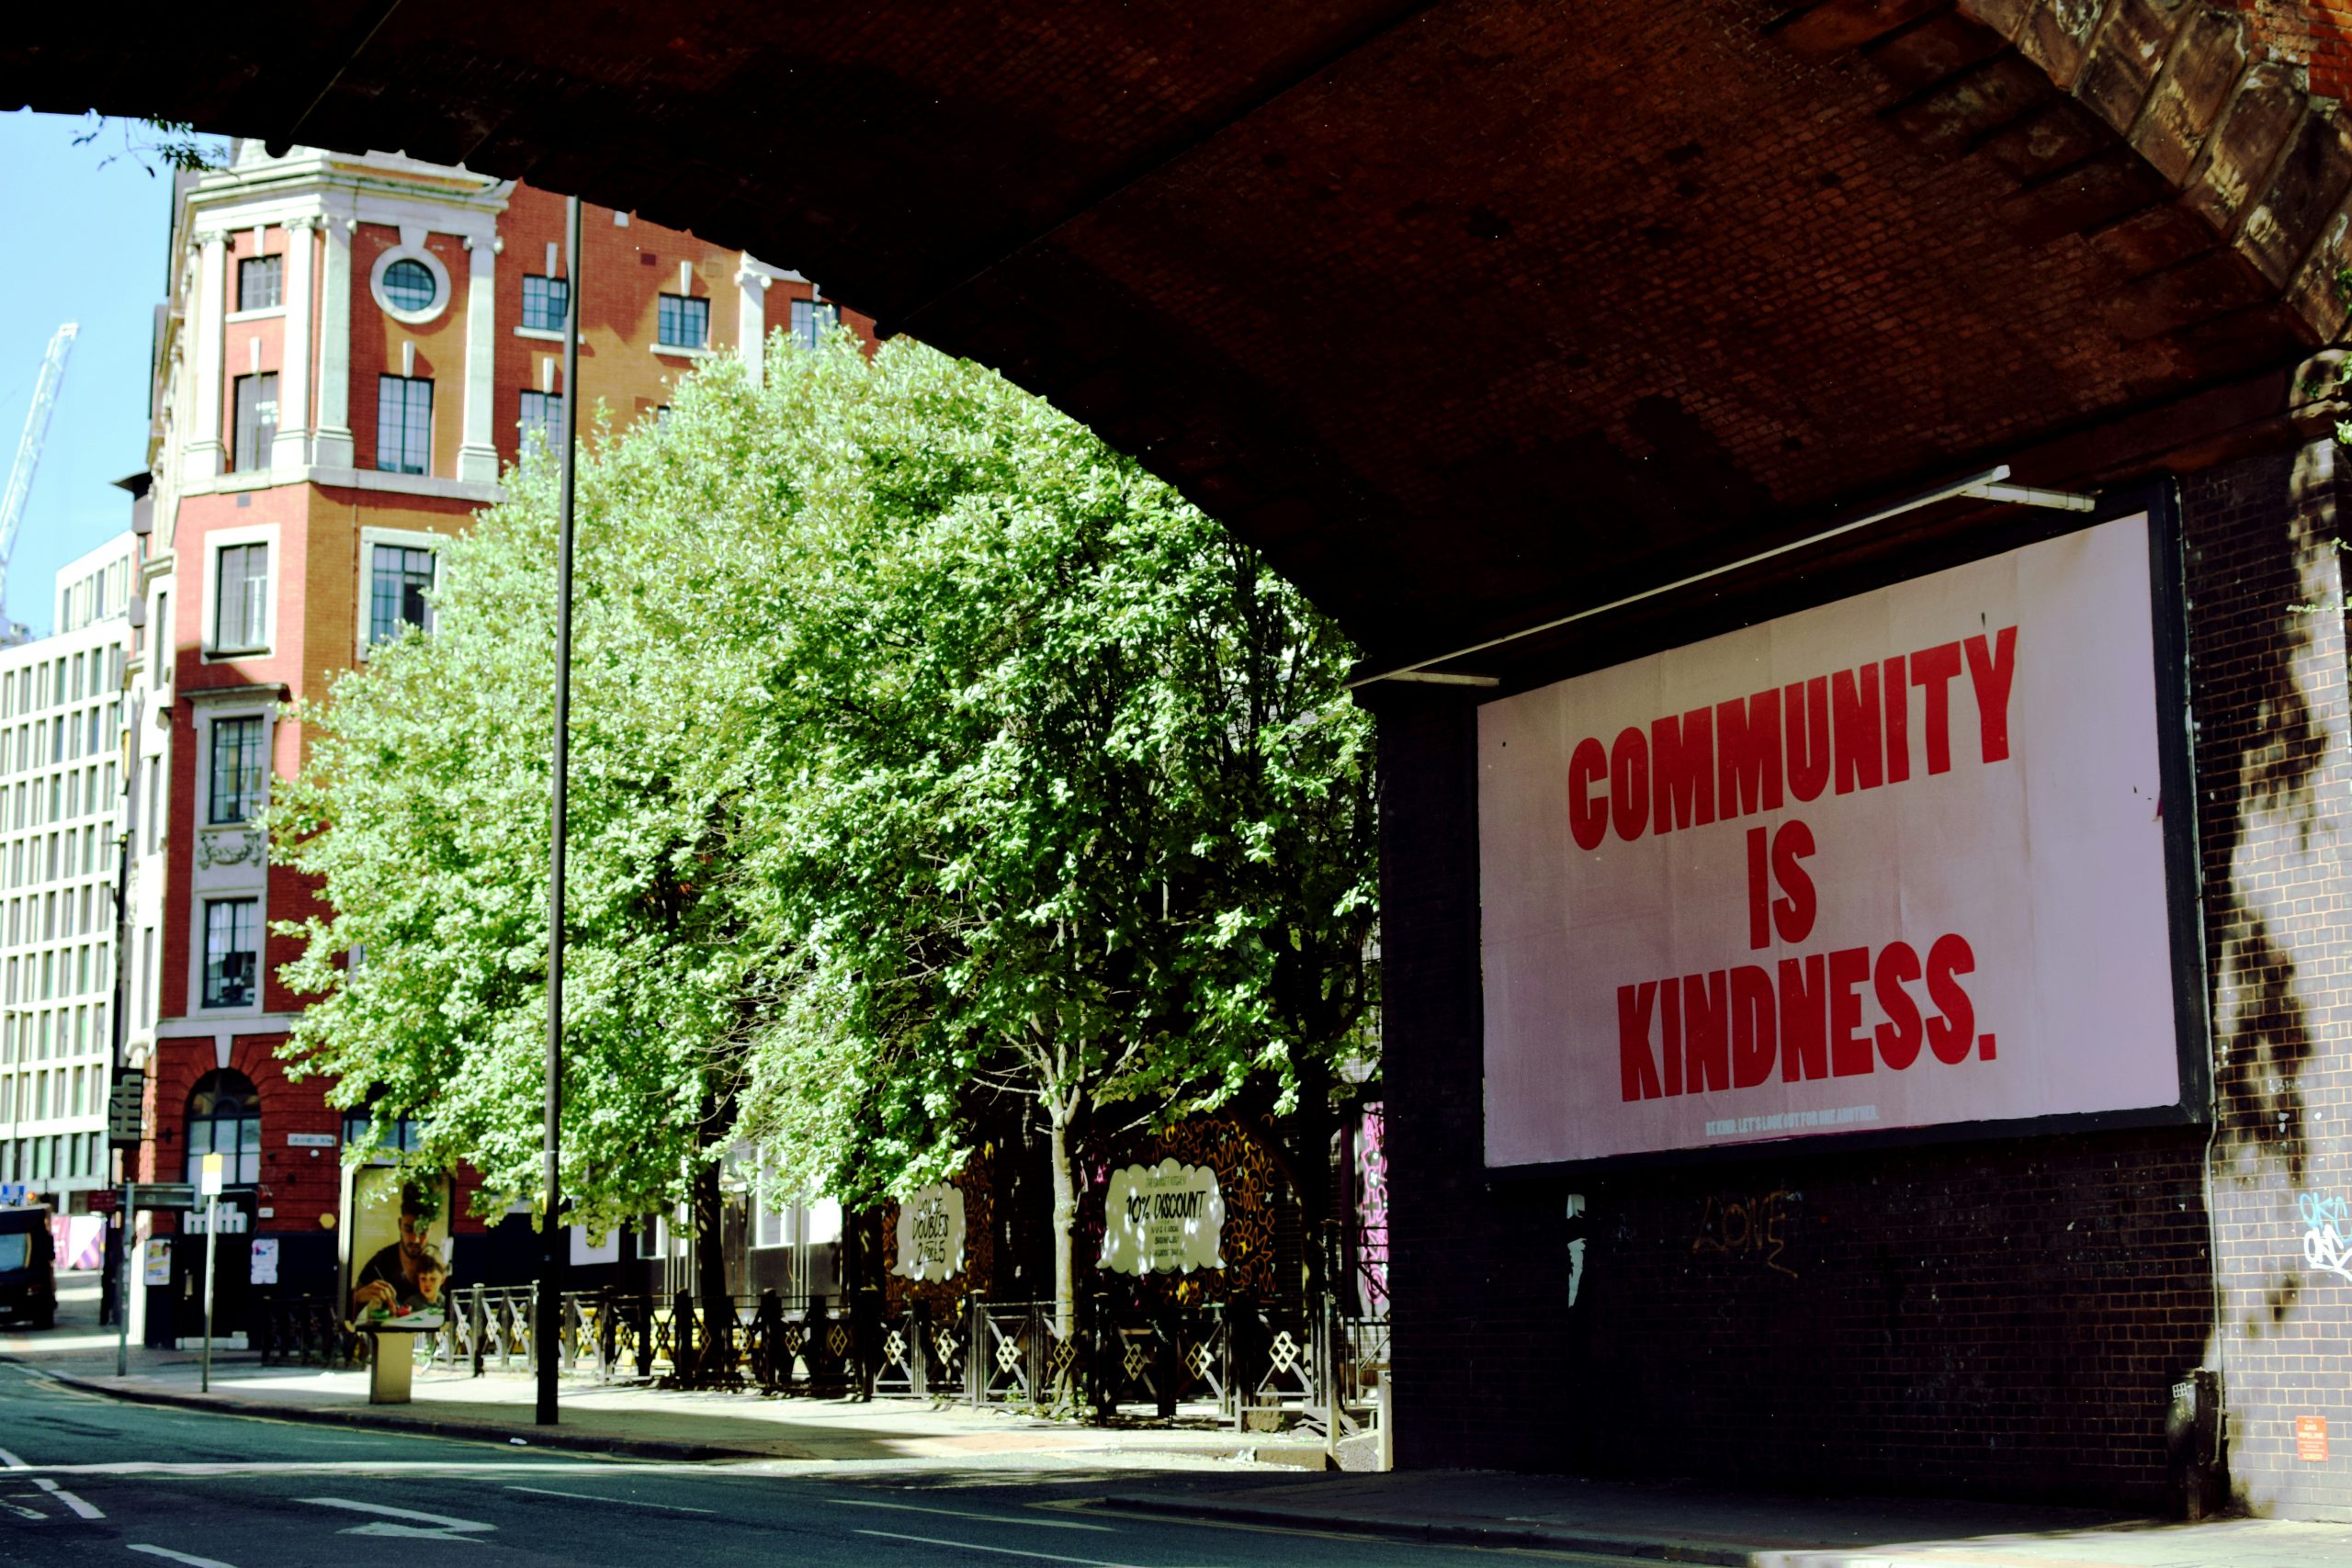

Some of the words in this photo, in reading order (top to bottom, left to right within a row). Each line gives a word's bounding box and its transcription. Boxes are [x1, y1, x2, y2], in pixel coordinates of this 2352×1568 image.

[1567, 626, 2018, 851] COMMUNITY
[1747, 819, 1817, 951] IS
[1617, 932, 1997, 1102] KINDNESS.
[912, 1213, 949, 1240] DOUBLES
[1125, 1194, 1151, 1224] 10%
[1154, 1190, 1206, 1220] DISCOUNT
